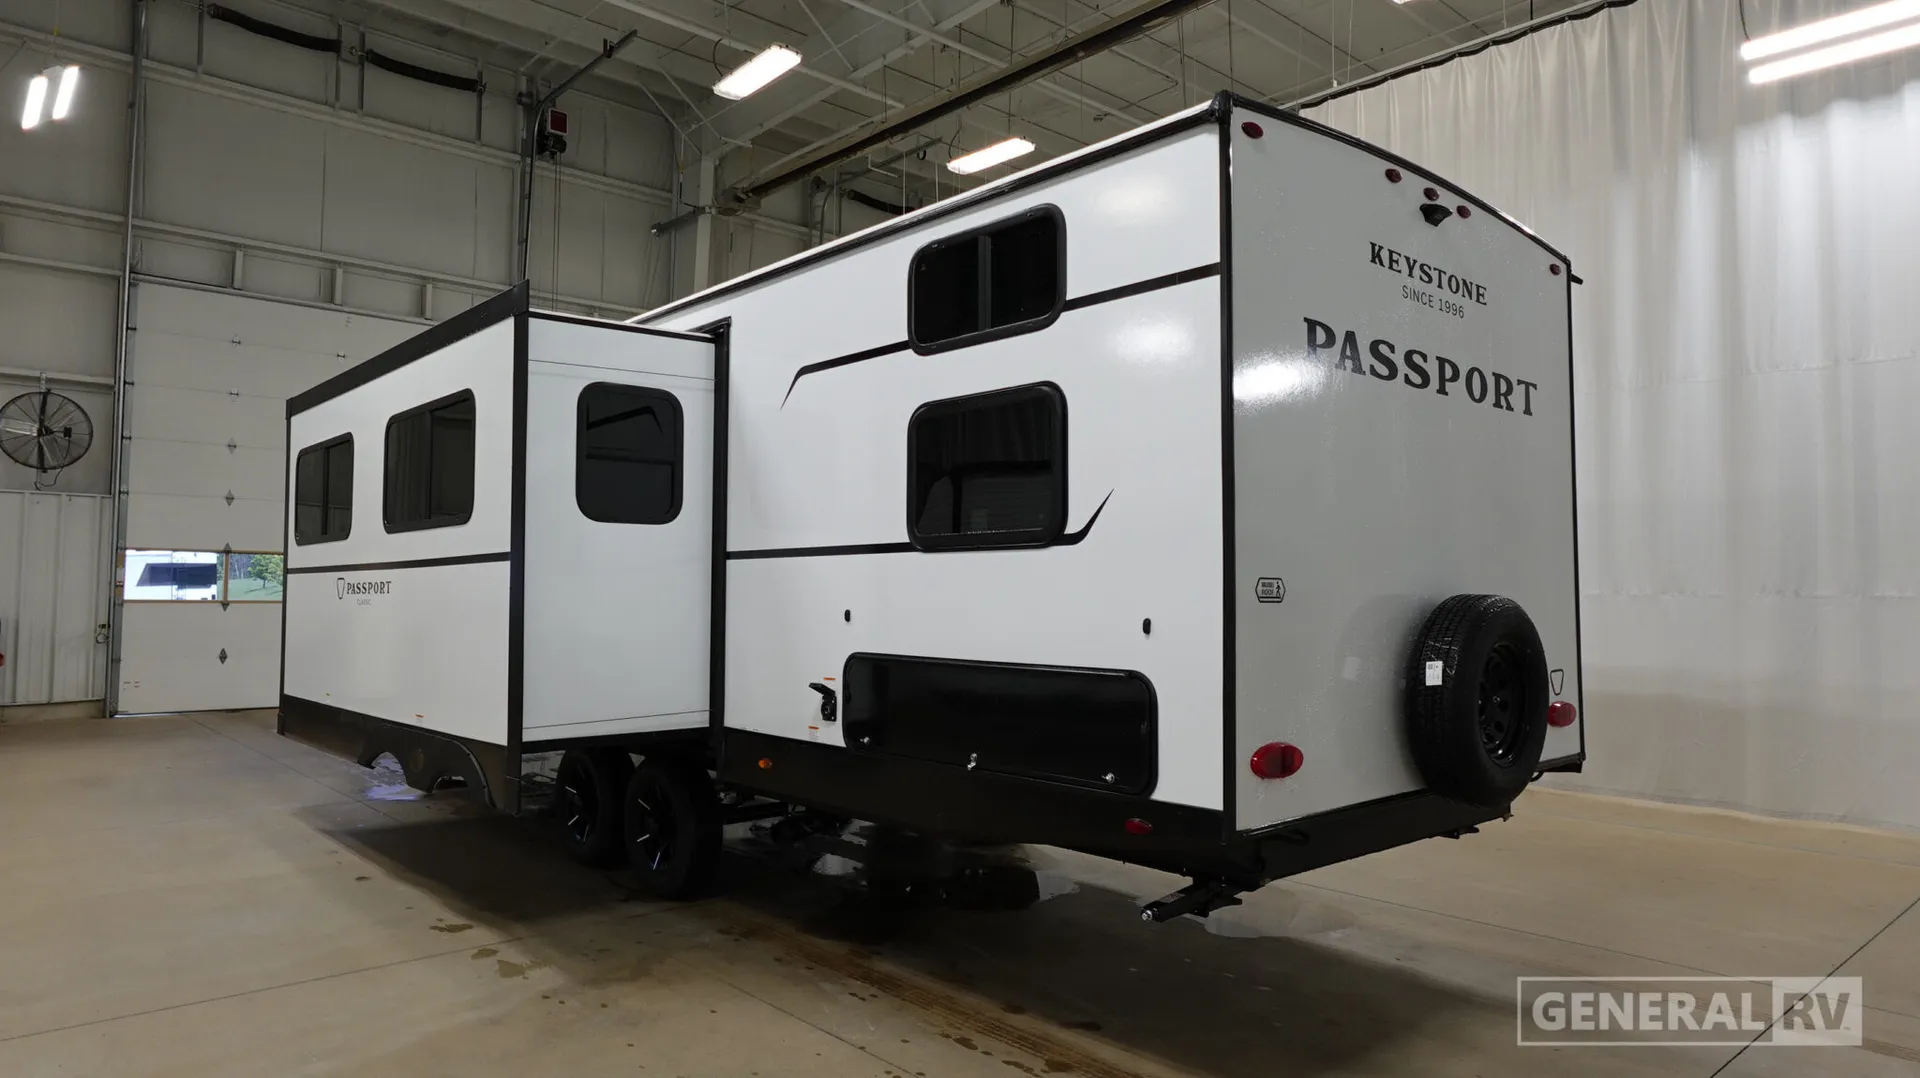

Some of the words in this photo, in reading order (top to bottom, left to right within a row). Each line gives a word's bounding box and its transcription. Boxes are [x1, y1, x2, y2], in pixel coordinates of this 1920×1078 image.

[1369, 241, 1487, 306] KEYSTONE
[1402, 285, 1434, 309] SINCE
[1438, 298, 1465, 319] 1996
[1303, 317, 1537, 417] PASSPORT
[346, 581, 392, 595] PASSPORT
